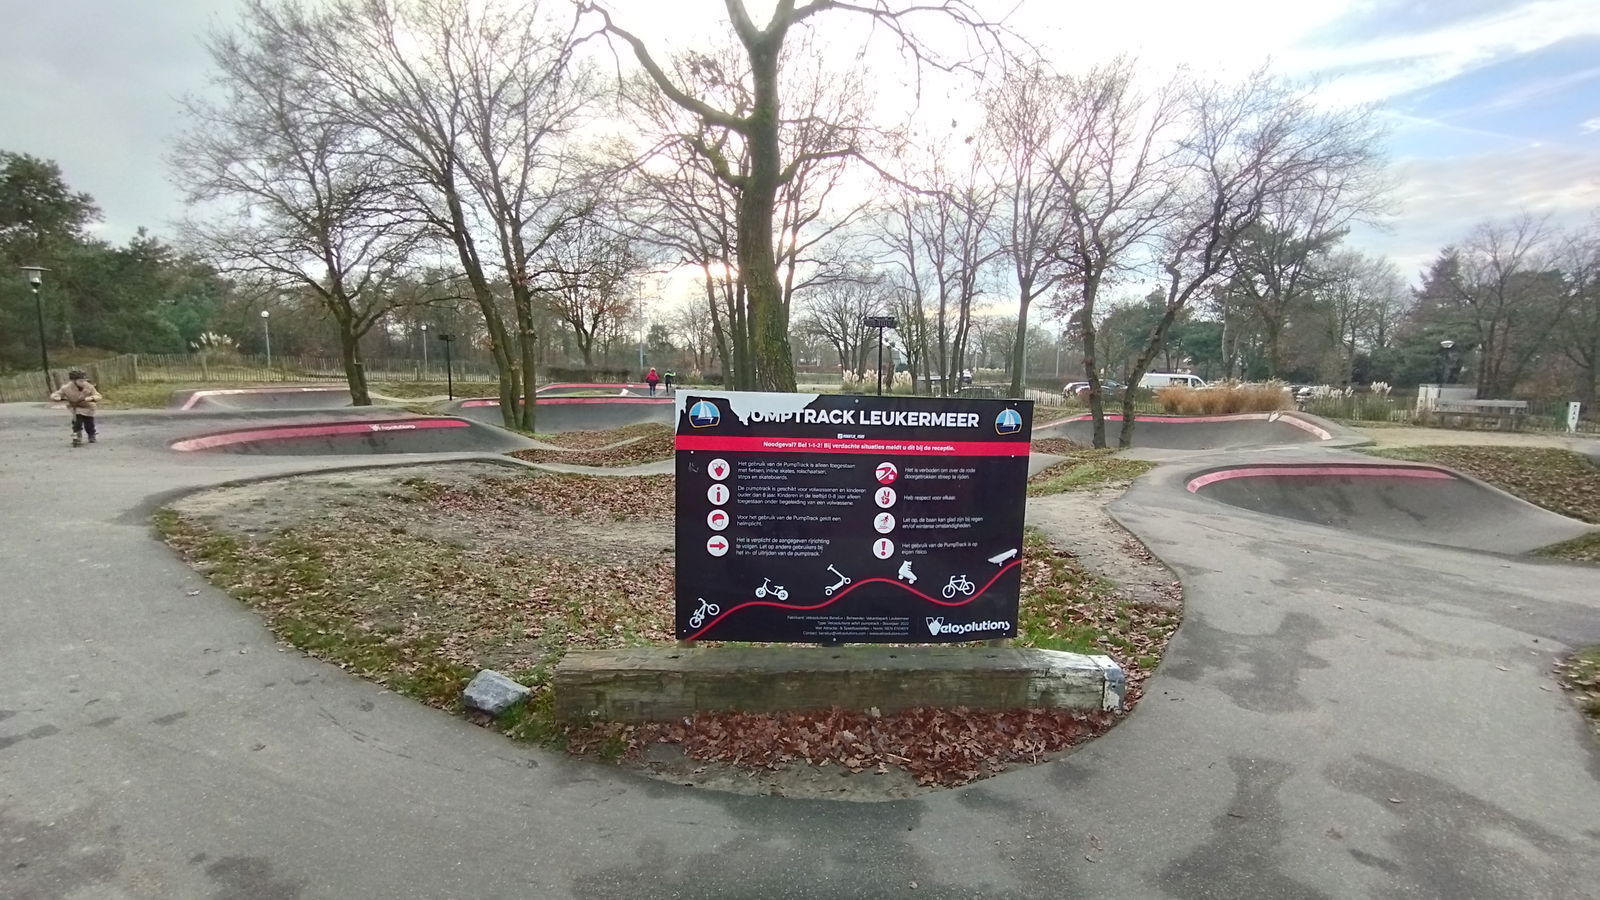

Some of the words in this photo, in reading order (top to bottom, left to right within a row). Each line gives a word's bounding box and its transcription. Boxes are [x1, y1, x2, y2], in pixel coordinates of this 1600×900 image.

[740, 408, 856, 425] UMPTRACK
[860, 410, 980, 428] LEUKERMEER
[763, 441, 796, 449] Noodgeval?
[926, 616, 1010, 636] Velosolutions
